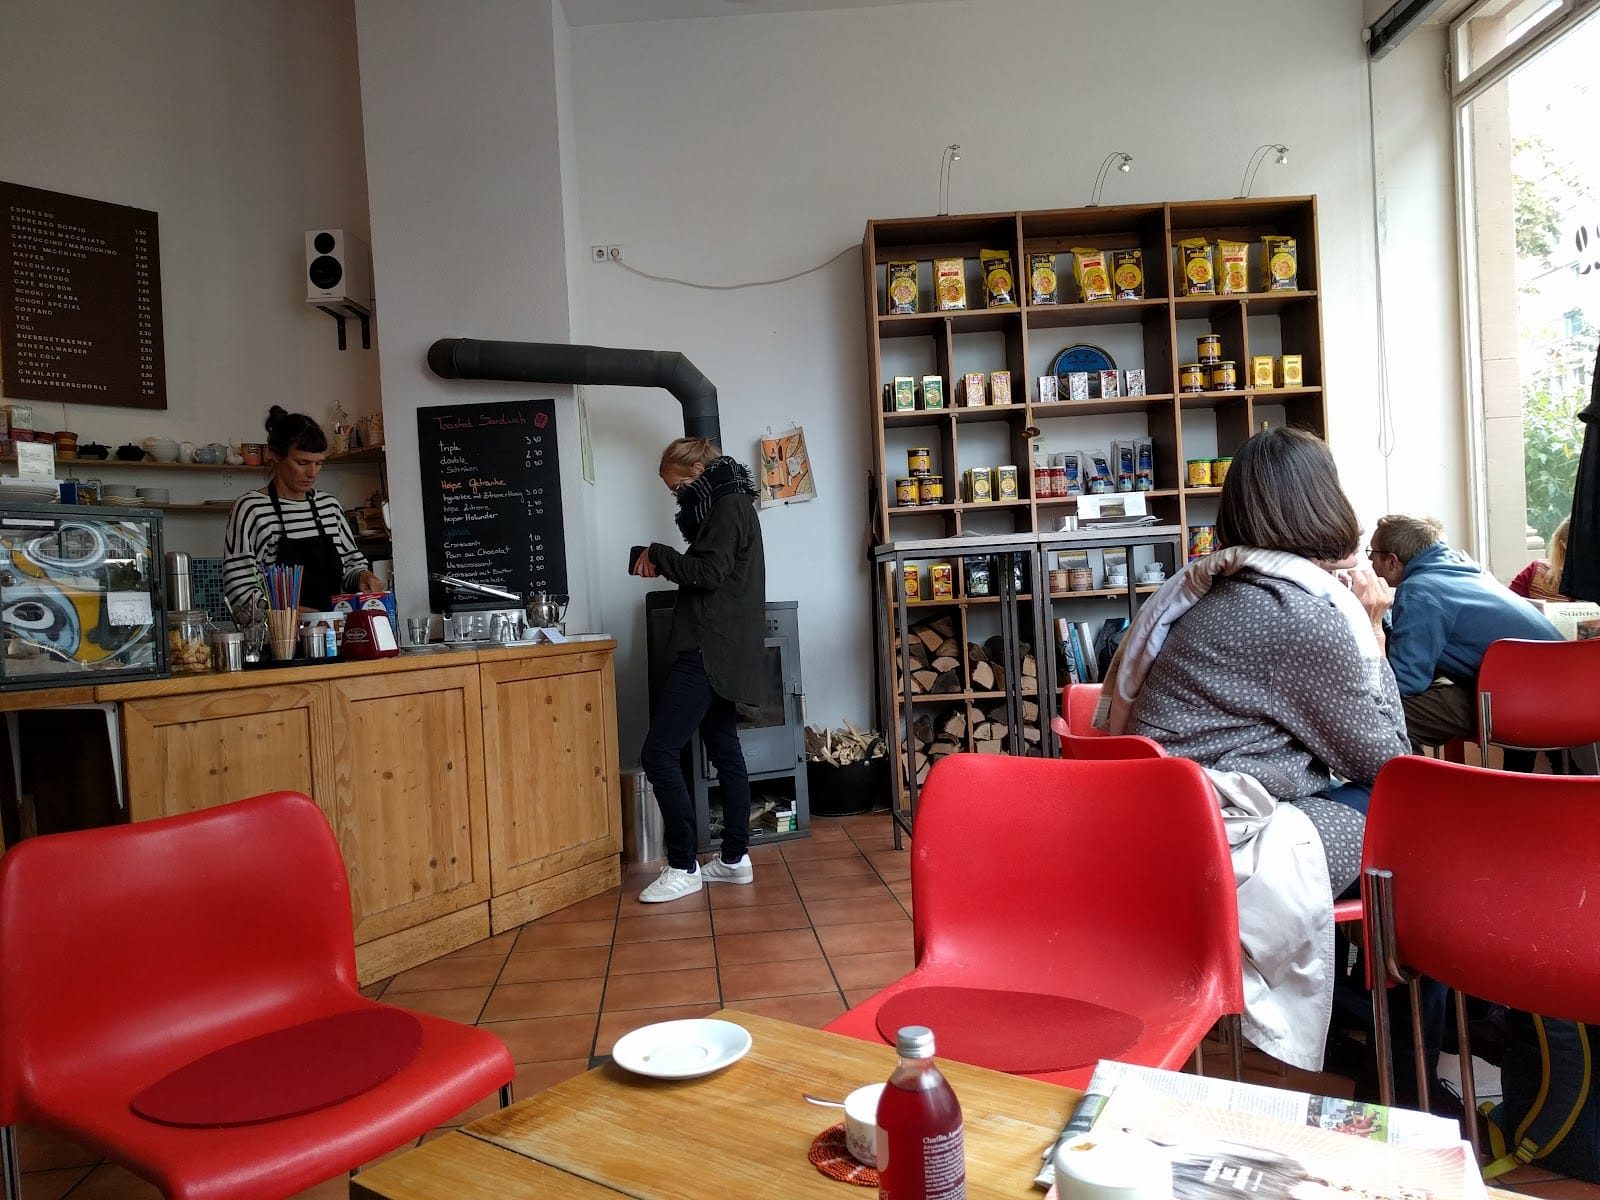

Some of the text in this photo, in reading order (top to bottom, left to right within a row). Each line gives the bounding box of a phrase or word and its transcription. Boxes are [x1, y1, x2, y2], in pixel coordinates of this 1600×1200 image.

[10, 206, 54, 219] ESPRESSO
[11, 215, 54, 227] ESPRESSO
[57, 223, 86, 233] DOPPIO
[12, 224, 55, 236] ESPRESSO
[58, 232, 106, 245] MACCHIATO
[12, 242, 37, 251] LATTE
[13, 251, 44, 261] KAFFEE
[13, 260, 71, 274] MILCHKAFFEE
[39, 273, 70, 282] FREDDO
[15, 287, 44, 297] SCHOKI
[57, 293, 79, 301] KABA
[14, 296, 44, 305] SCHOKI
[47, 301, 81, 311] SPEZIAL
[14, 305, 53, 316] CORTADO
[15, 323, 34, 331] YOGI
[16, 333, 93, 347] SUESSGETRAENKE
[16, 342, 88, 354] MINERALWASSER
[479, 411, 527, 426] Sandwich
[439, 440, 461, 455] triple
[440, 456, 469, 465] double
[465, 511, 499, 521] Holunder
[445, 550, 462, 559] Pain
[477, 546, 511, 556] Chocolat
